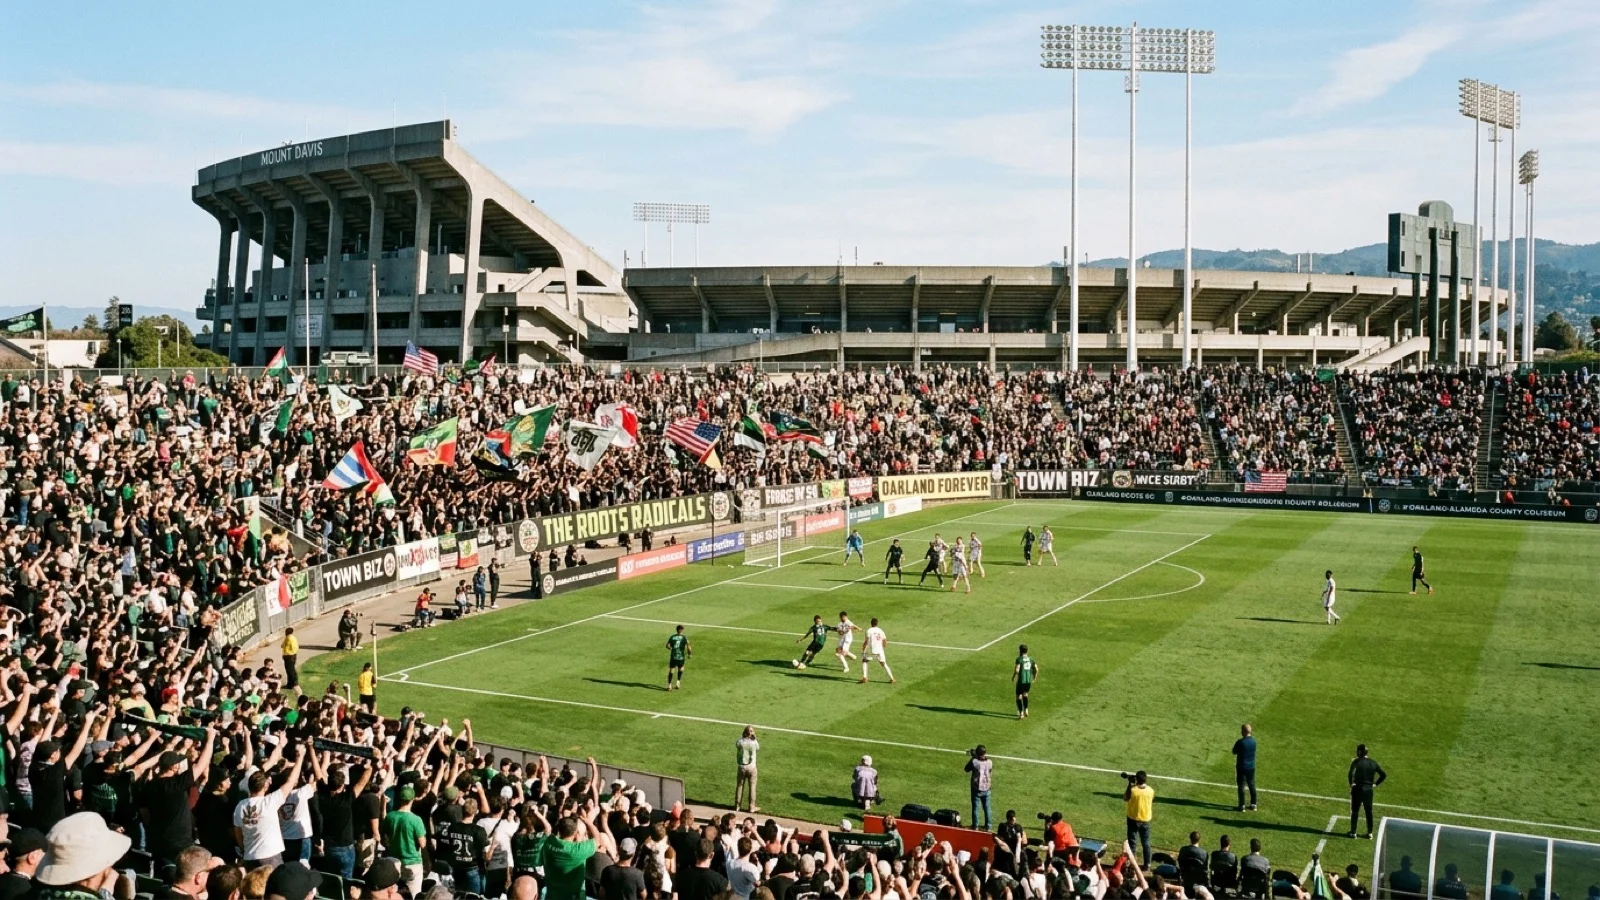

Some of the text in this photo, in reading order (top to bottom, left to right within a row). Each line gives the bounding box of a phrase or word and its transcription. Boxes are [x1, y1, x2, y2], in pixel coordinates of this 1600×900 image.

[260, 141, 323, 166] MOUNT DAVIS
[937, 476, 989, 493] FOREVER
[1015, 471, 1068, 491] TOWN
[542, 496, 706, 546] THE ROOTS RADICALS
[1523, 509, 1566, 517] COLISEUM
[322, 563, 362, 593] TOWN
[363, 557, 384, 581] BIZ
